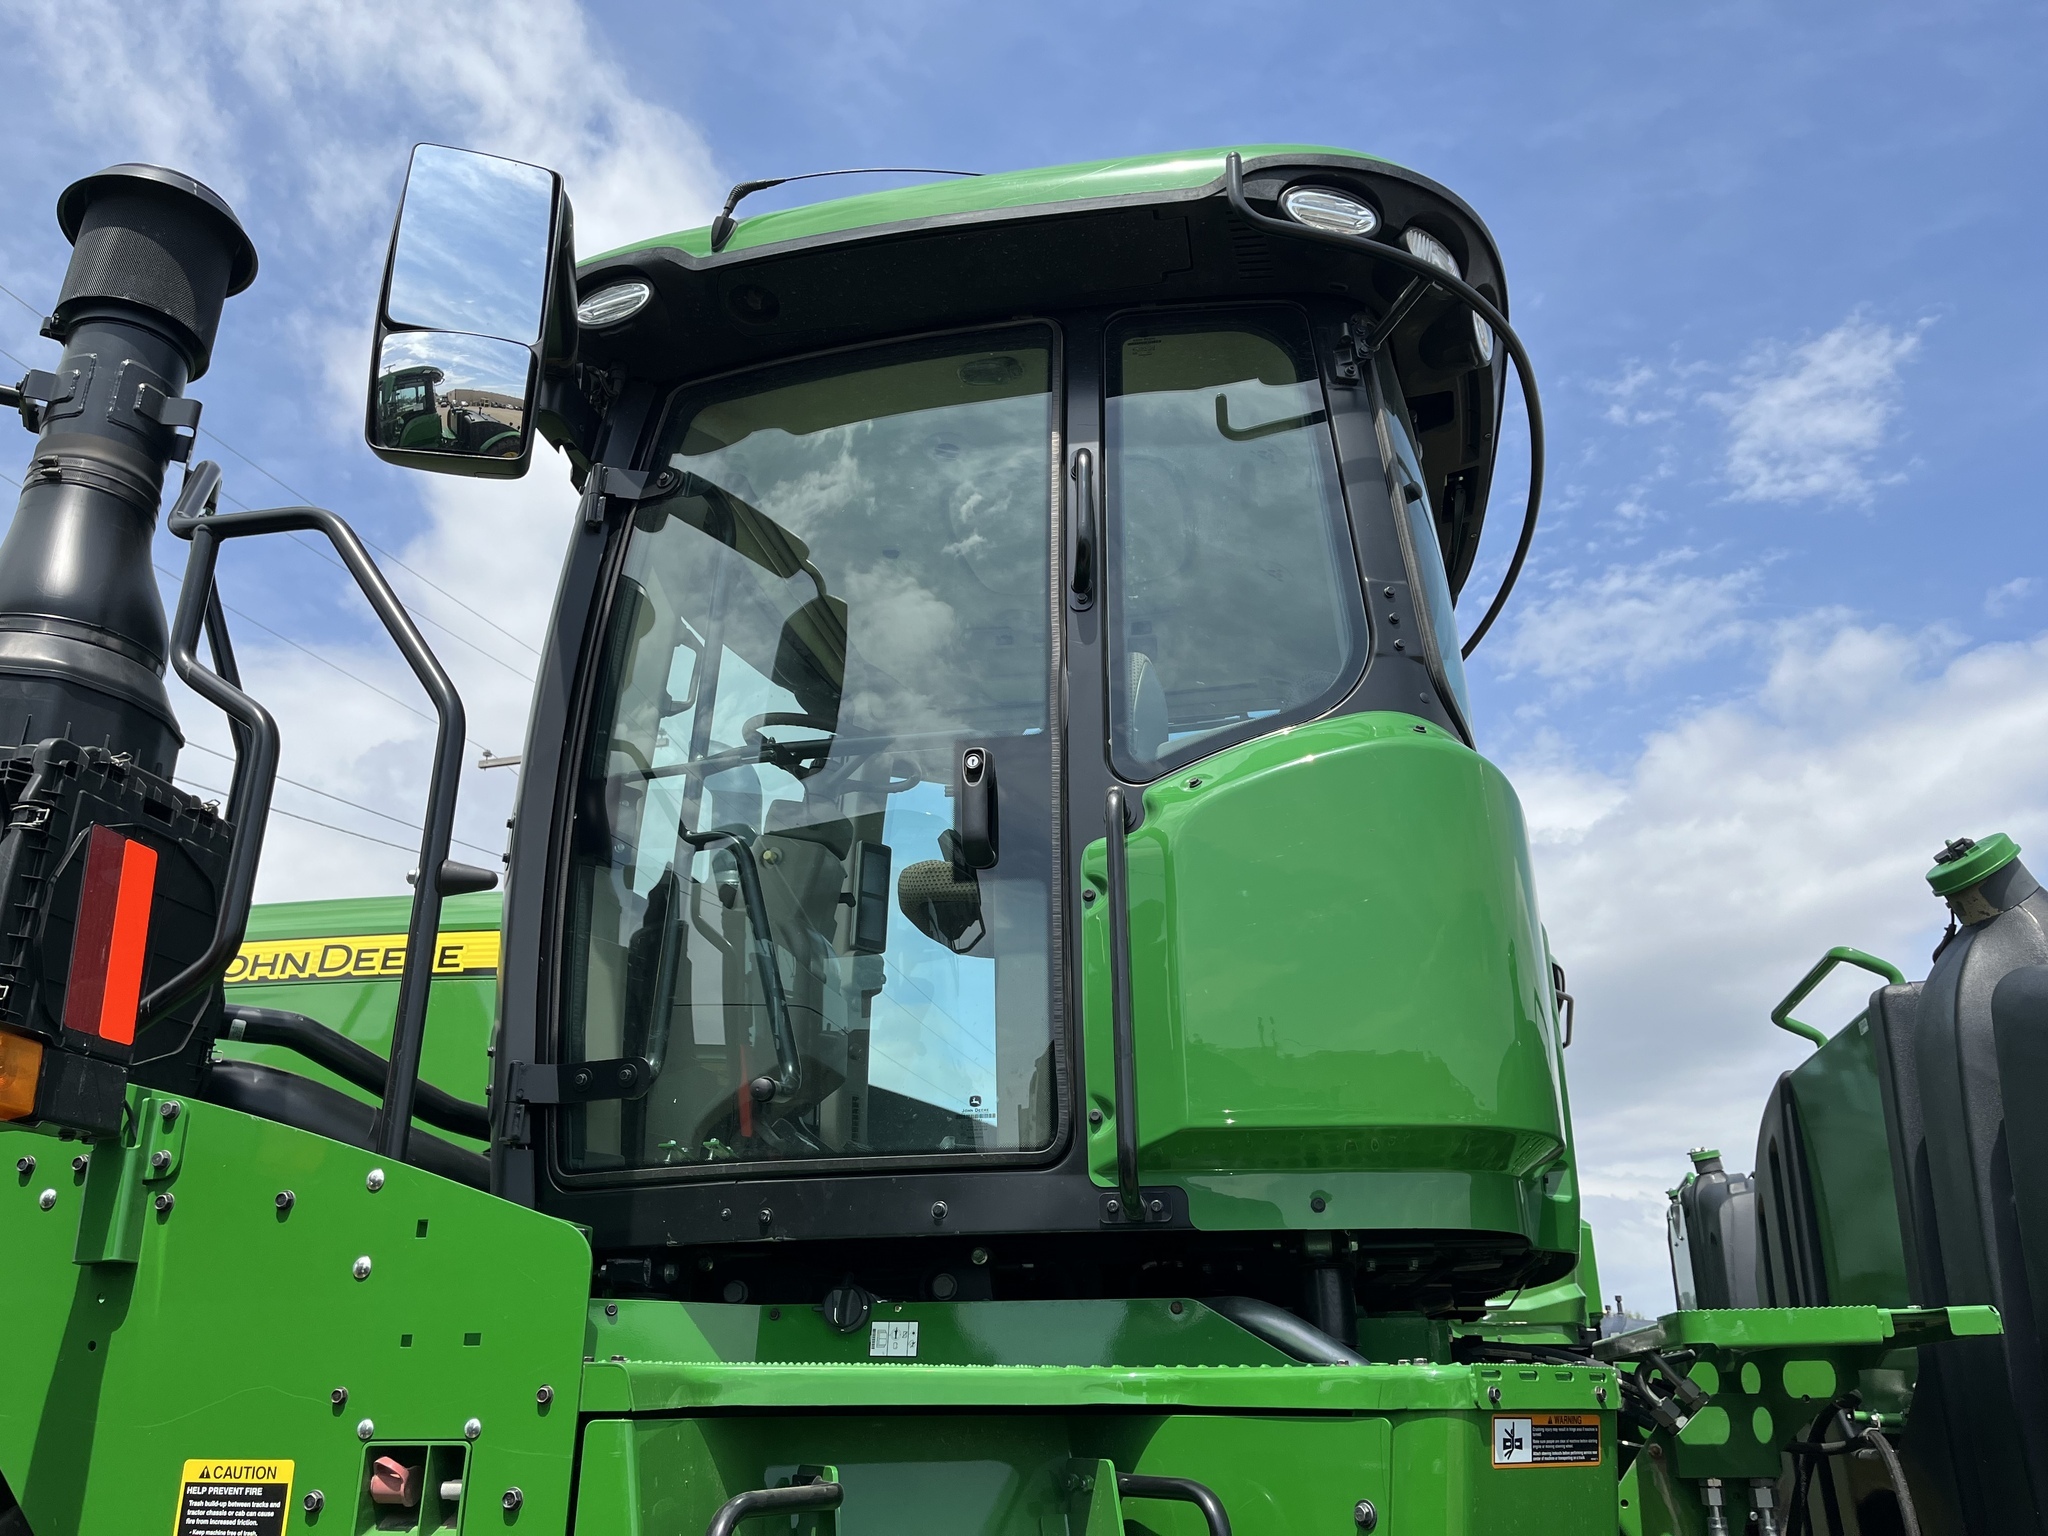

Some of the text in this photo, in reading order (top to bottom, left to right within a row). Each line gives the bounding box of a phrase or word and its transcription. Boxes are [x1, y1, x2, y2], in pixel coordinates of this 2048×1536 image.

[224, 944, 464, 978] OHN DEEE
[1554, 1416, 1582, 1424] WARNING
[213, 1466, 277, 1479] CAUTION
[186, 1486, 263, 1496] HELP PREVENT FIRE
[204, 1500, 227, 1508] build-up
